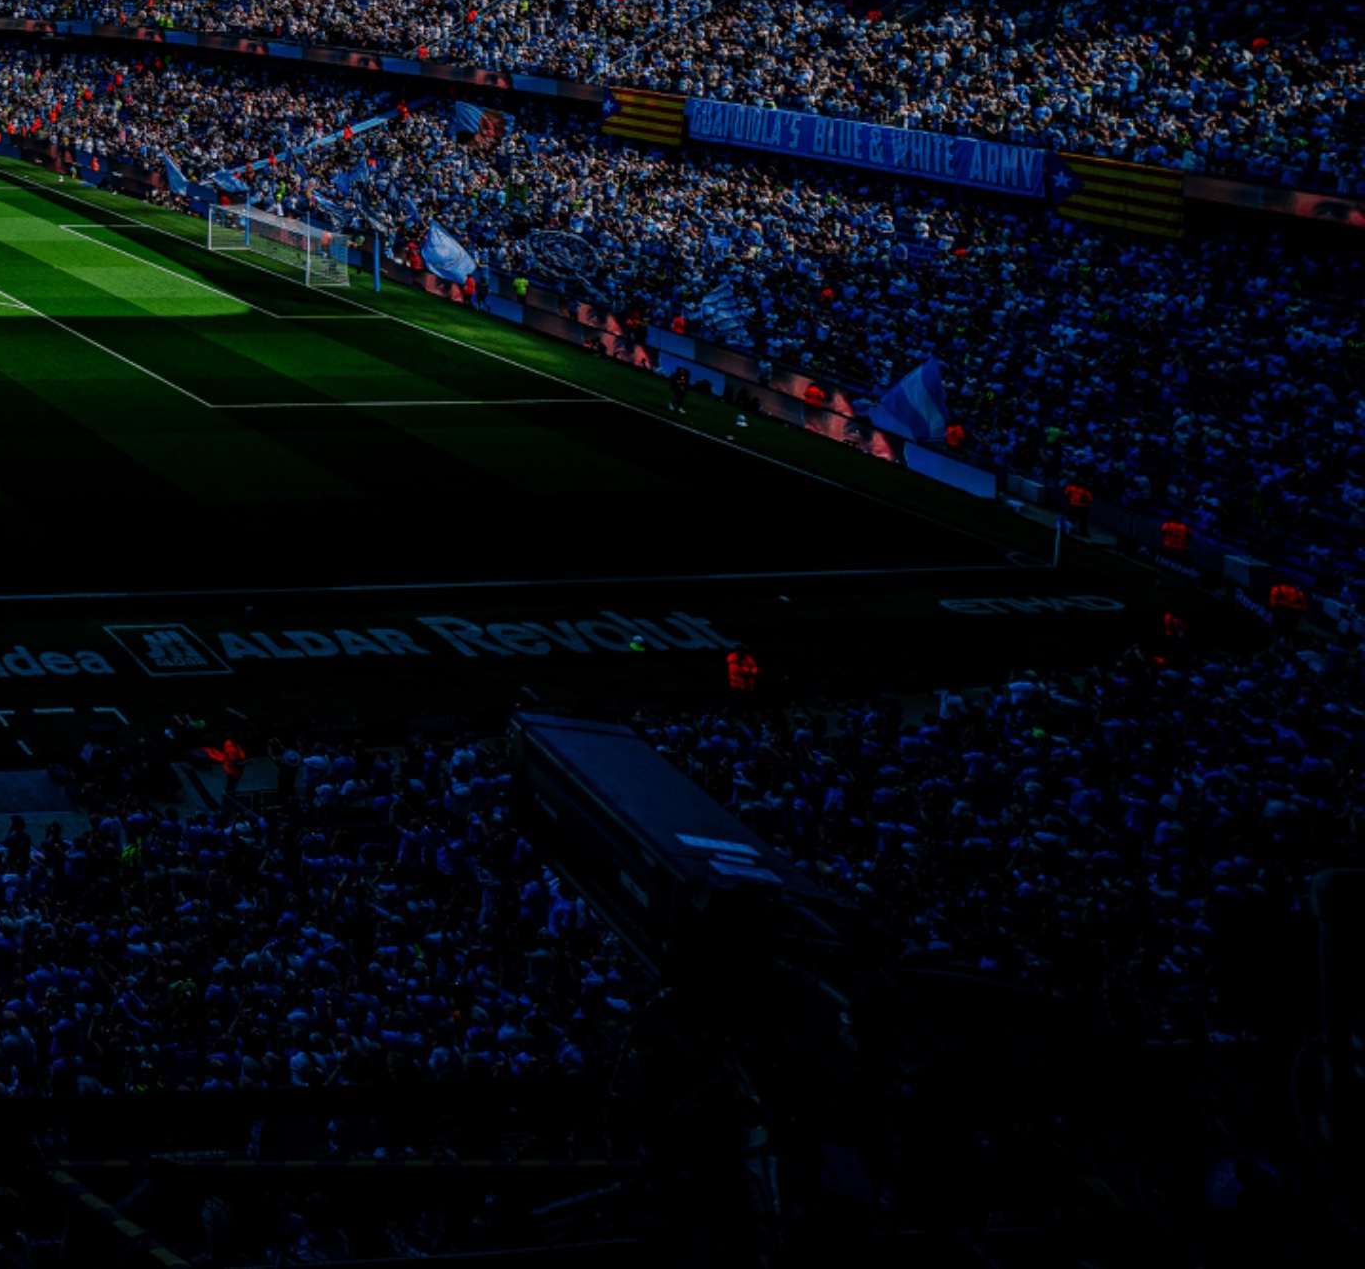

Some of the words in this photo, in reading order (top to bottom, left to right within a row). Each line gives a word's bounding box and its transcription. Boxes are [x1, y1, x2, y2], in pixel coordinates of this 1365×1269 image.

[812, 117, 865, 161] BLUE
[869, 129, 886, 164] &
[890, 130, 956, 176] WHITE
[967, 142, 1036, 189] ARMY
[938, 594, 1127, 616] ETIHAD
[217, 629, 432, 661] ALDAR
[414, 609, 748, 658] Revolut
